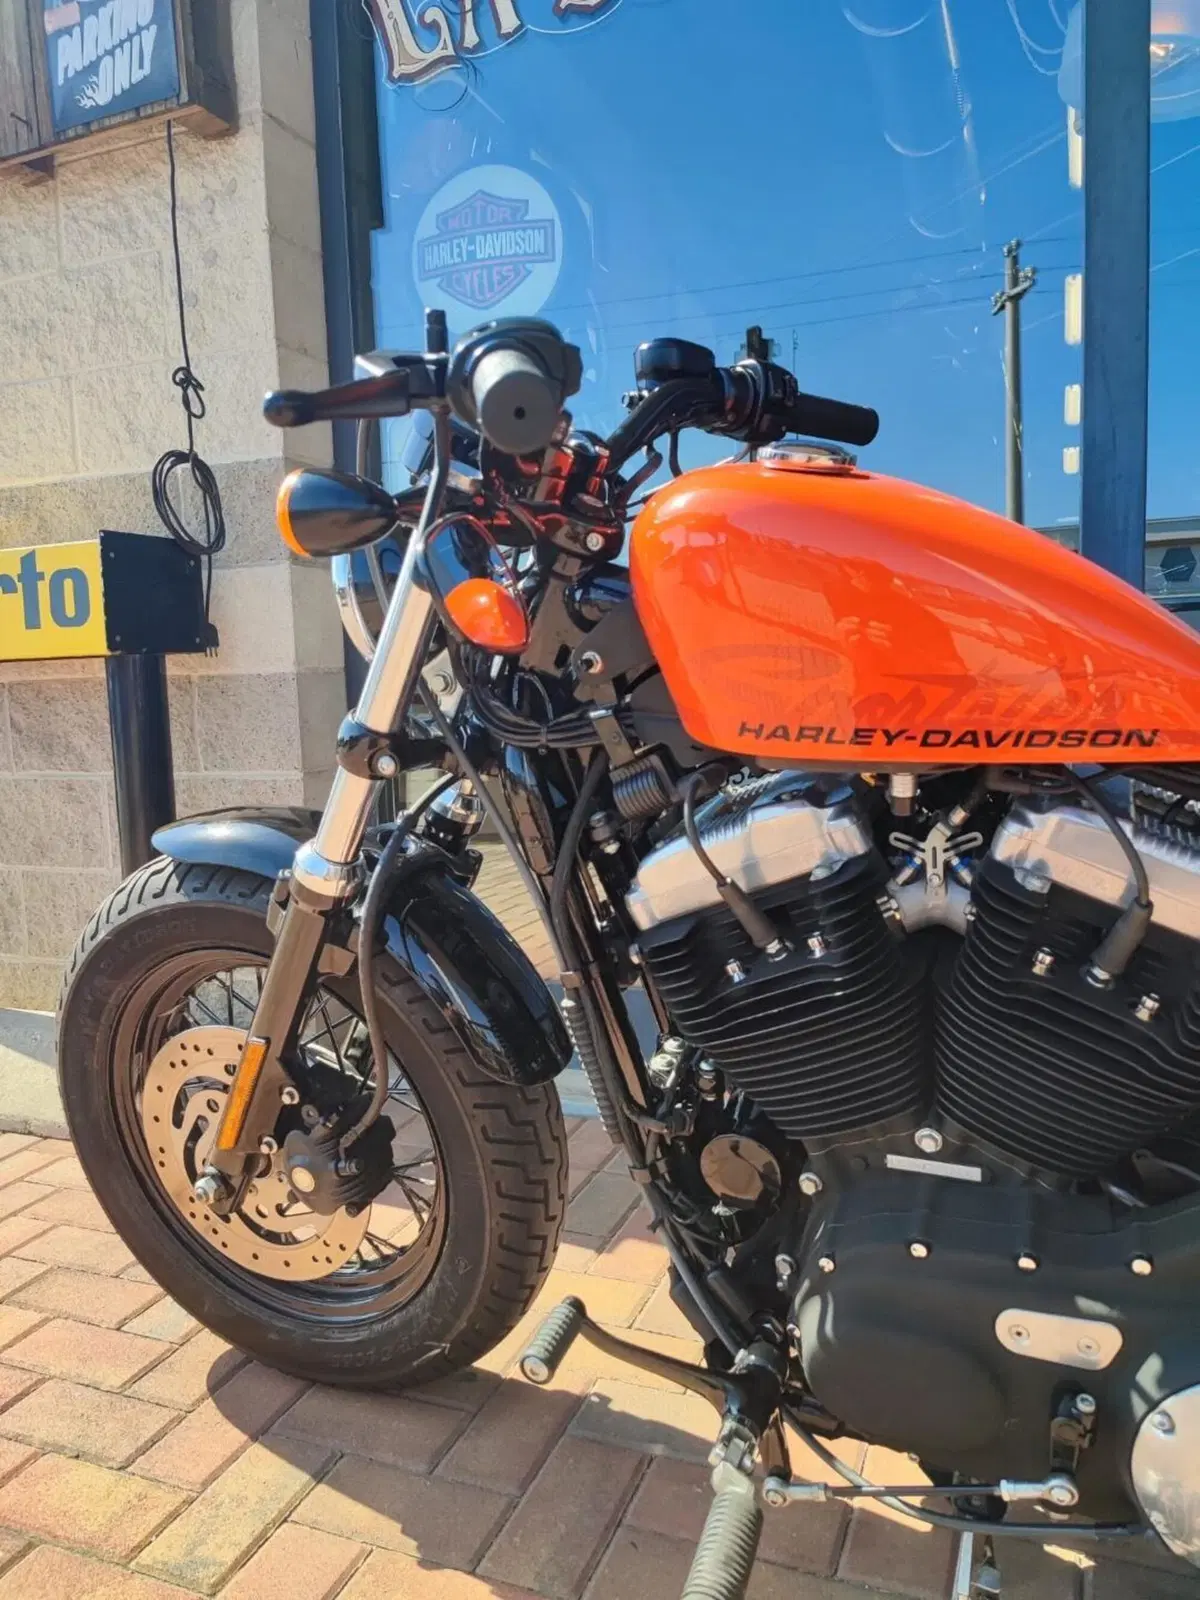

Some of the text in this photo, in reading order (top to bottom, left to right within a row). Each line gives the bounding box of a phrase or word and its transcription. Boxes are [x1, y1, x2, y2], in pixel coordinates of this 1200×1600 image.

[96, 25, 158, 106] ONLY
[424, 228, 546, 271] HARLEY-DAVIDSON
[451, 264, 515, 300] CYCLES
[737, 721, 1160, 749] HARLEY-DAVIDSON
